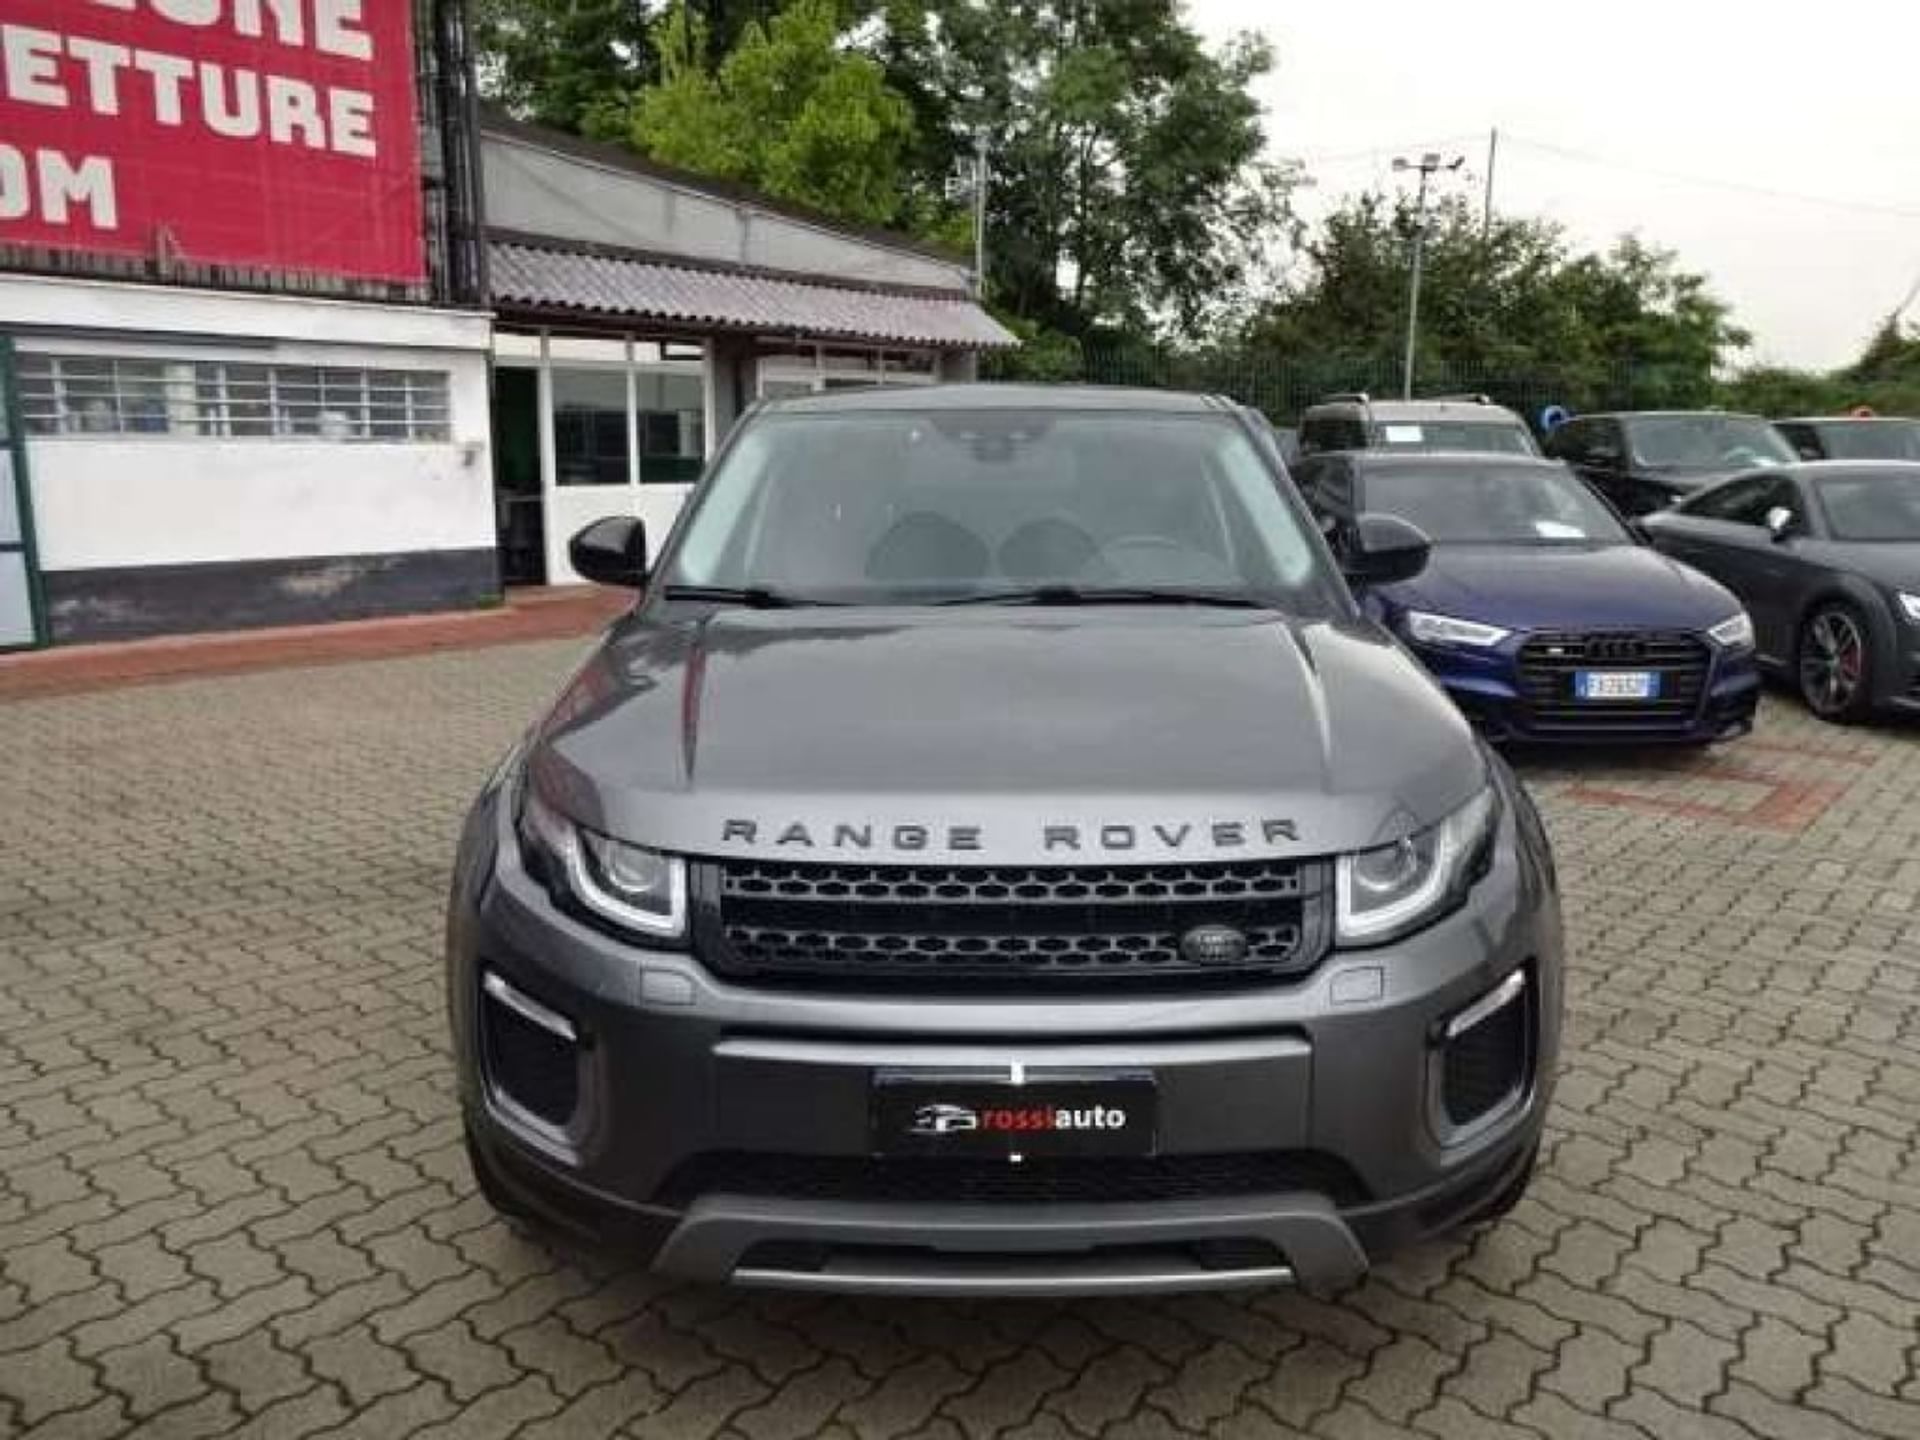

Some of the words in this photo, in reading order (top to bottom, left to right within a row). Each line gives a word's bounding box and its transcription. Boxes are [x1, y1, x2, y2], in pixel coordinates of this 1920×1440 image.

[0, 24, 377, 158] ETTURE
[722, 819, 982, 851] RANGE
[1043, 819, 1300, 851] ROVER
[980, 1104, 1127, 1130] rossiauto
